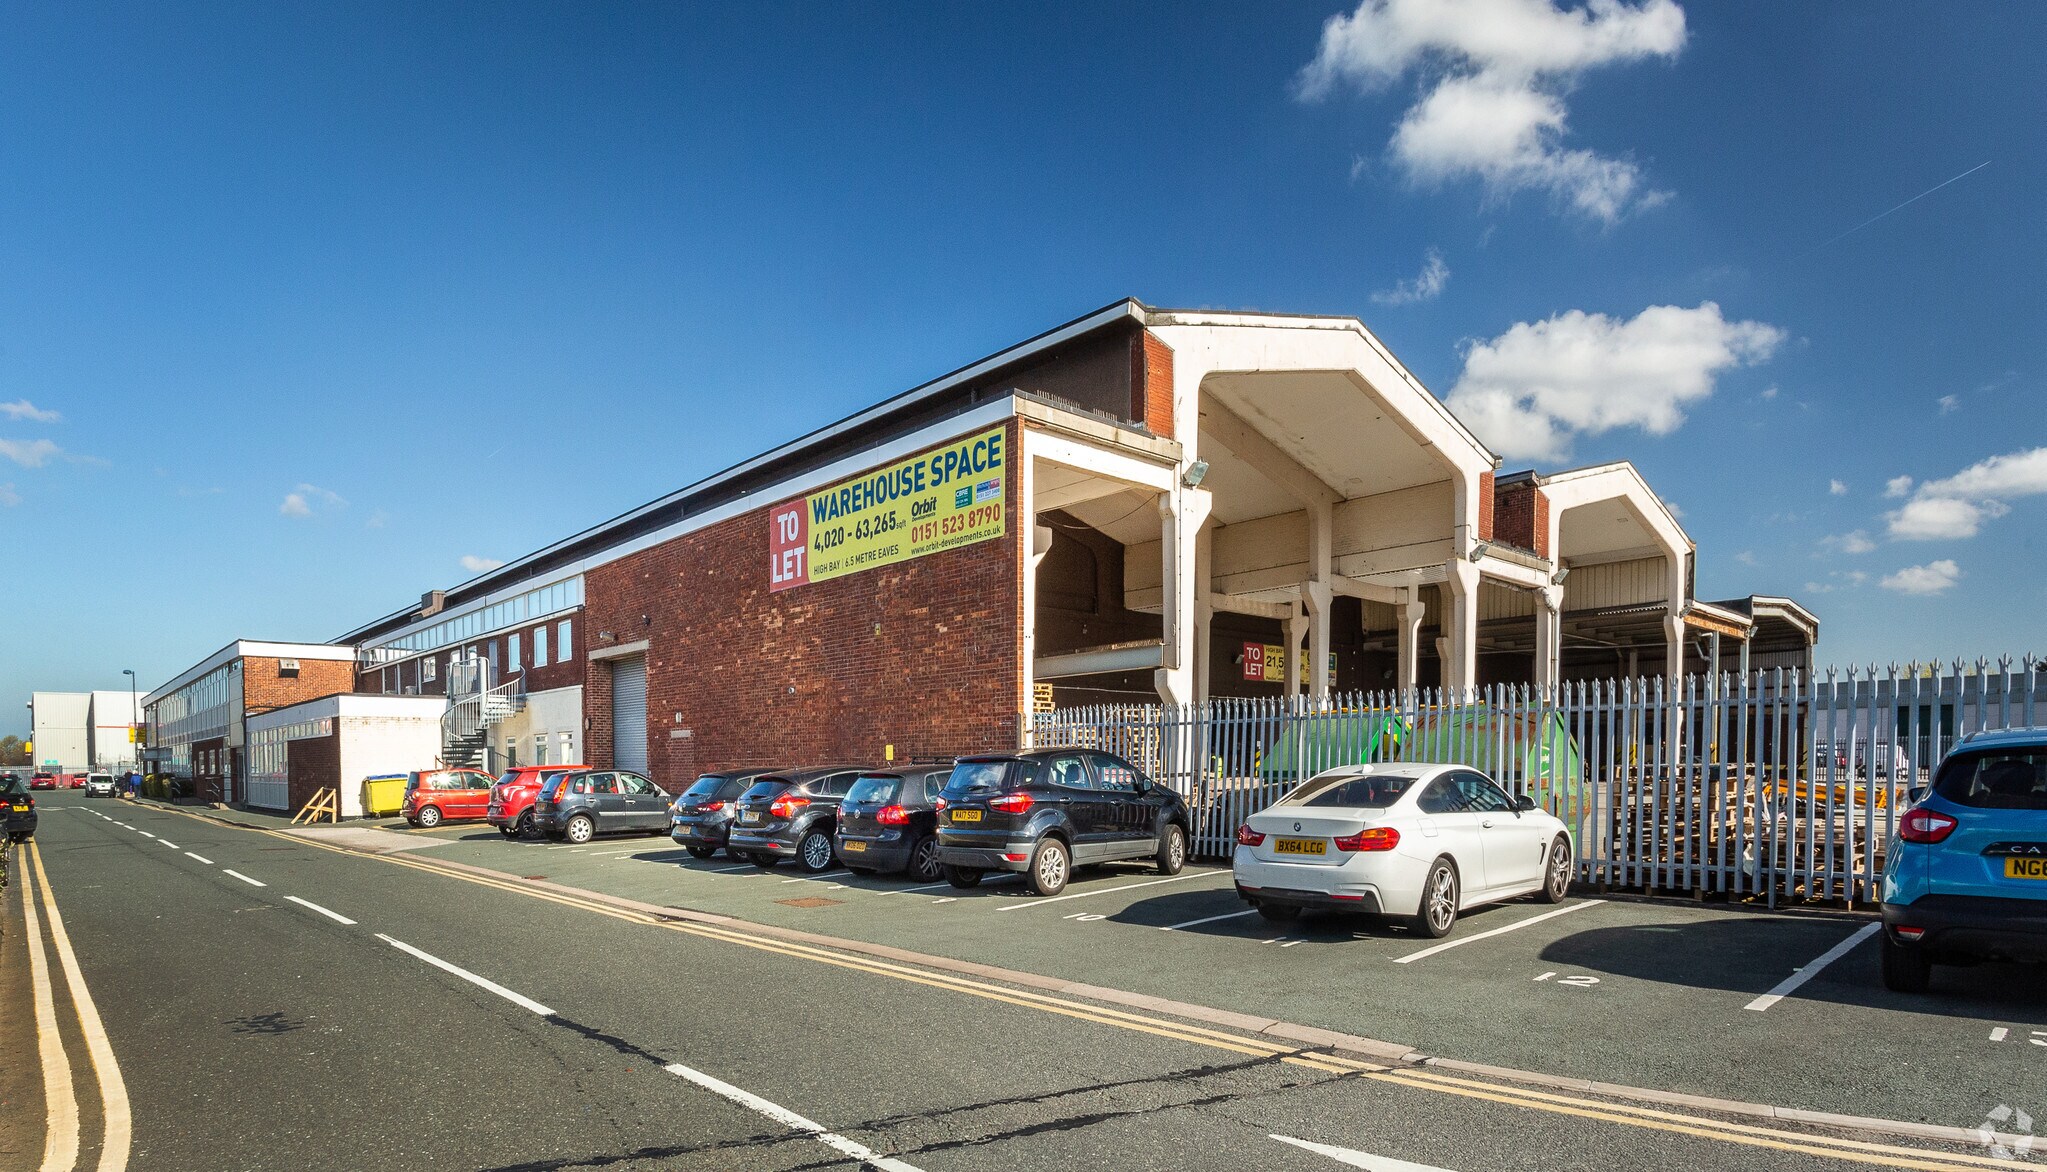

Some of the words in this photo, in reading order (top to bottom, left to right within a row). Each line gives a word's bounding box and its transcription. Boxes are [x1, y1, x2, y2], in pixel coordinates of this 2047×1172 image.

[813, 461, 926, 525] WAREHOUSE
[931, 434, 1002, 487] SPACE
[955, 488, 969, 498] CBRE
[911, 496, 937, 517] Orbit
[777, 510, 799, 545] TO
[814, 526, 845, 554] 4,020
[855, 510, 896, 540] 63,265
[911, 520, 938, 544] 0151
[942, 513, 965, 536] 523
[968, 503, 1001, 529] 8790
[910, 525, 1001, 556] www.orbit-developments.co.uk
[772, 545, 805, 584] LET
[813, 564, 828, 576] HIGH
[828, 559, 841, 572] BAY
[845, 555, 855, 568] 6.5
[855, 549, 877, 565] METRE
[878, 544, 899, 558] EAVES
[1246, 647, 1261, 660] TO
[1266, 655, 1284, 670] 21,5
[1245, 662, 1263, 676] LET
[1278, 840, 1302, 852] BX64
[1303, 841, 1323, 853] LCG
[1063, 912, 1107, 922] 10
[1532, 971, 1601, 987] 12
